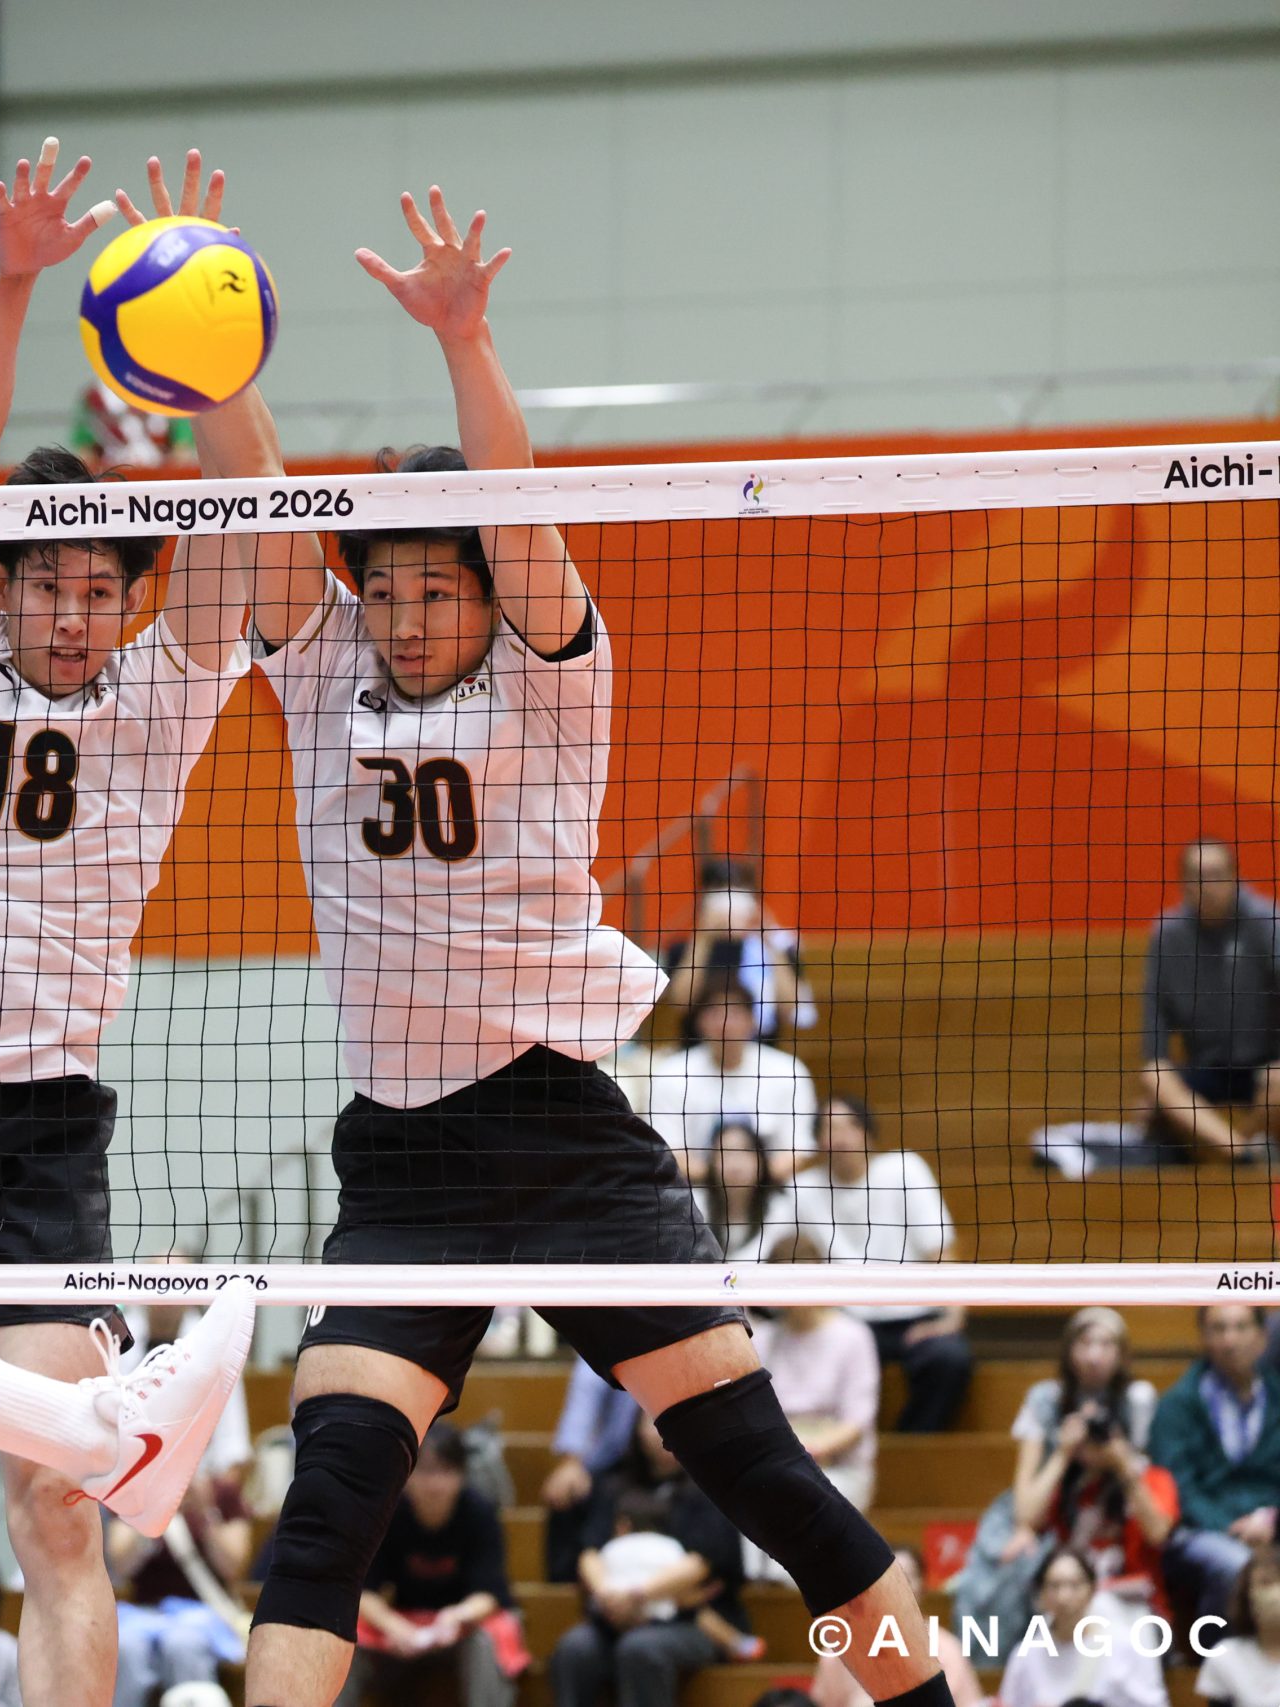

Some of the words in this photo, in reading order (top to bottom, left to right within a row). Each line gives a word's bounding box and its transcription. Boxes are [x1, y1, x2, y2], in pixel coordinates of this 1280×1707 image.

[1163, 453, 1280, 489] Aichi-
[25, 493, 258, 531] Aichi-Nagoya
[269, 488, 354, 518] 2026
[458, 681, 487, 698] JPN
[355, 757, 479, 864] 30
[64, 1271, 209, 1295] Aichi-Nagoya
[215, 1274, 268, 1291] 26
